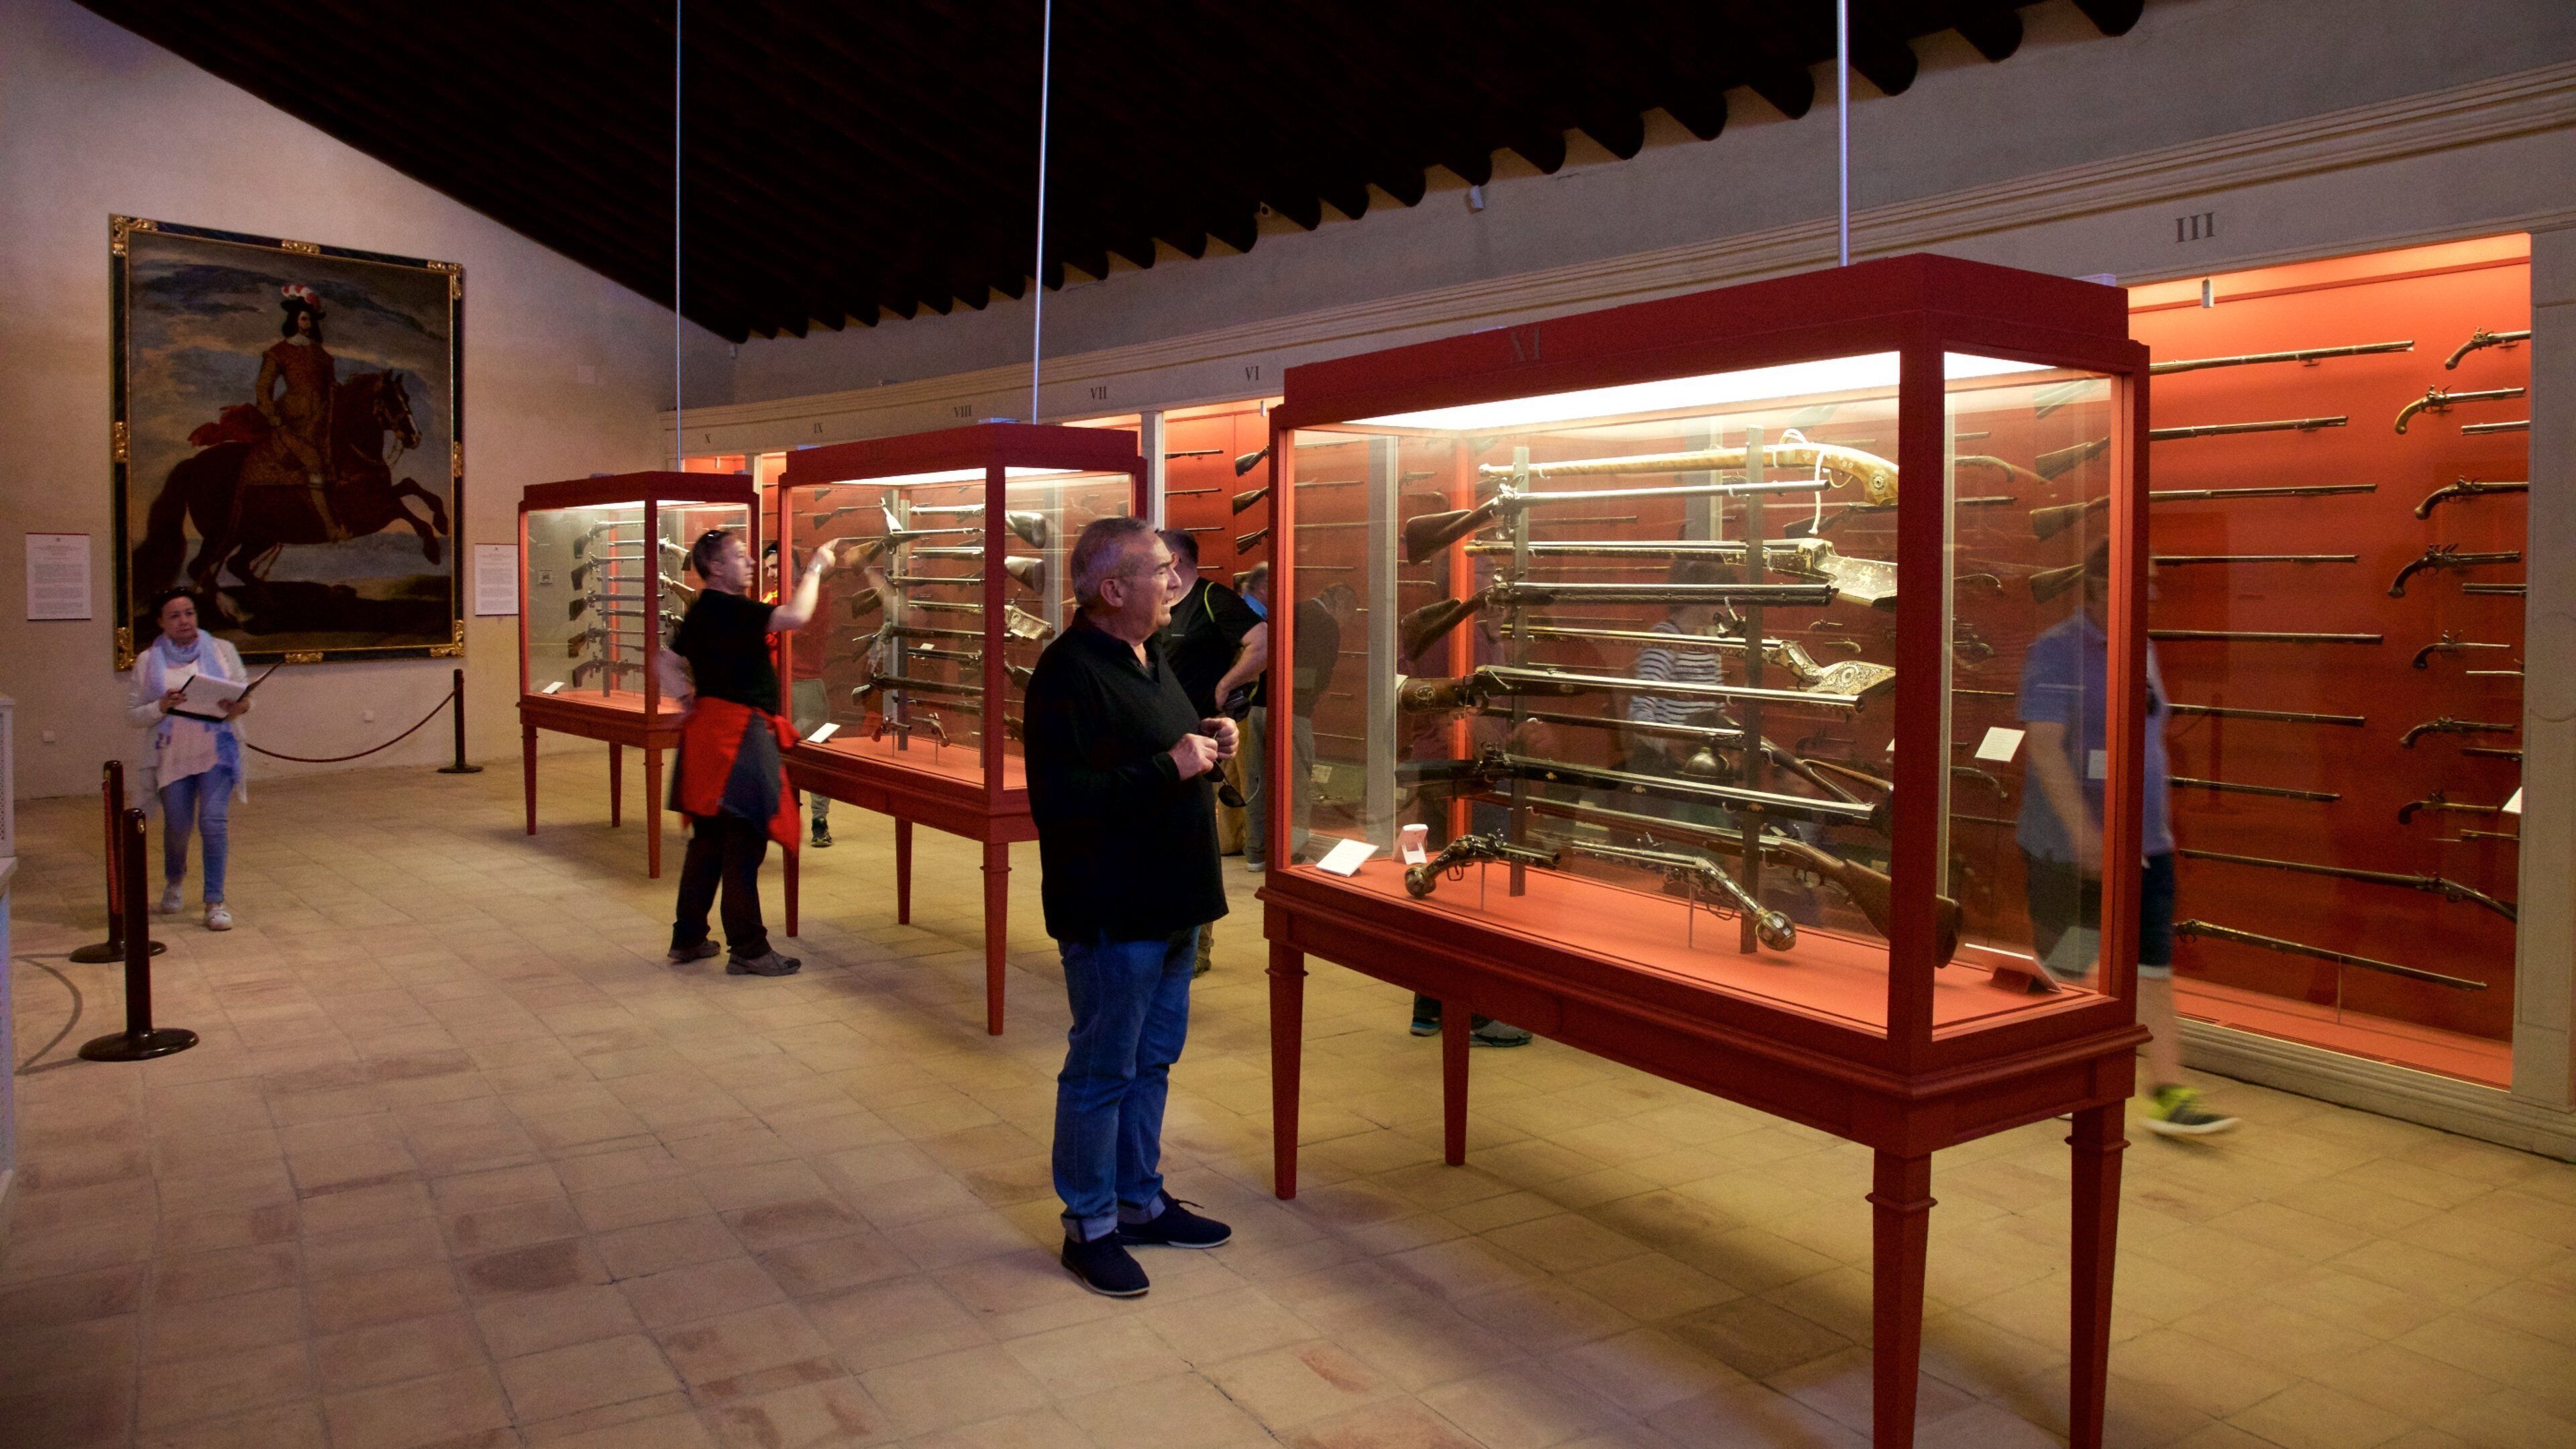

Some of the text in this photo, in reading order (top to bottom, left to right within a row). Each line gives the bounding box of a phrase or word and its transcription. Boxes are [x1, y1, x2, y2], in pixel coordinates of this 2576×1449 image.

[2176, 212, 2215, 244] III
[1246, 366, 1259, 381] VI
[1090, 386, 1106, 400] VII
[955, 405, 971, 417] VIII
